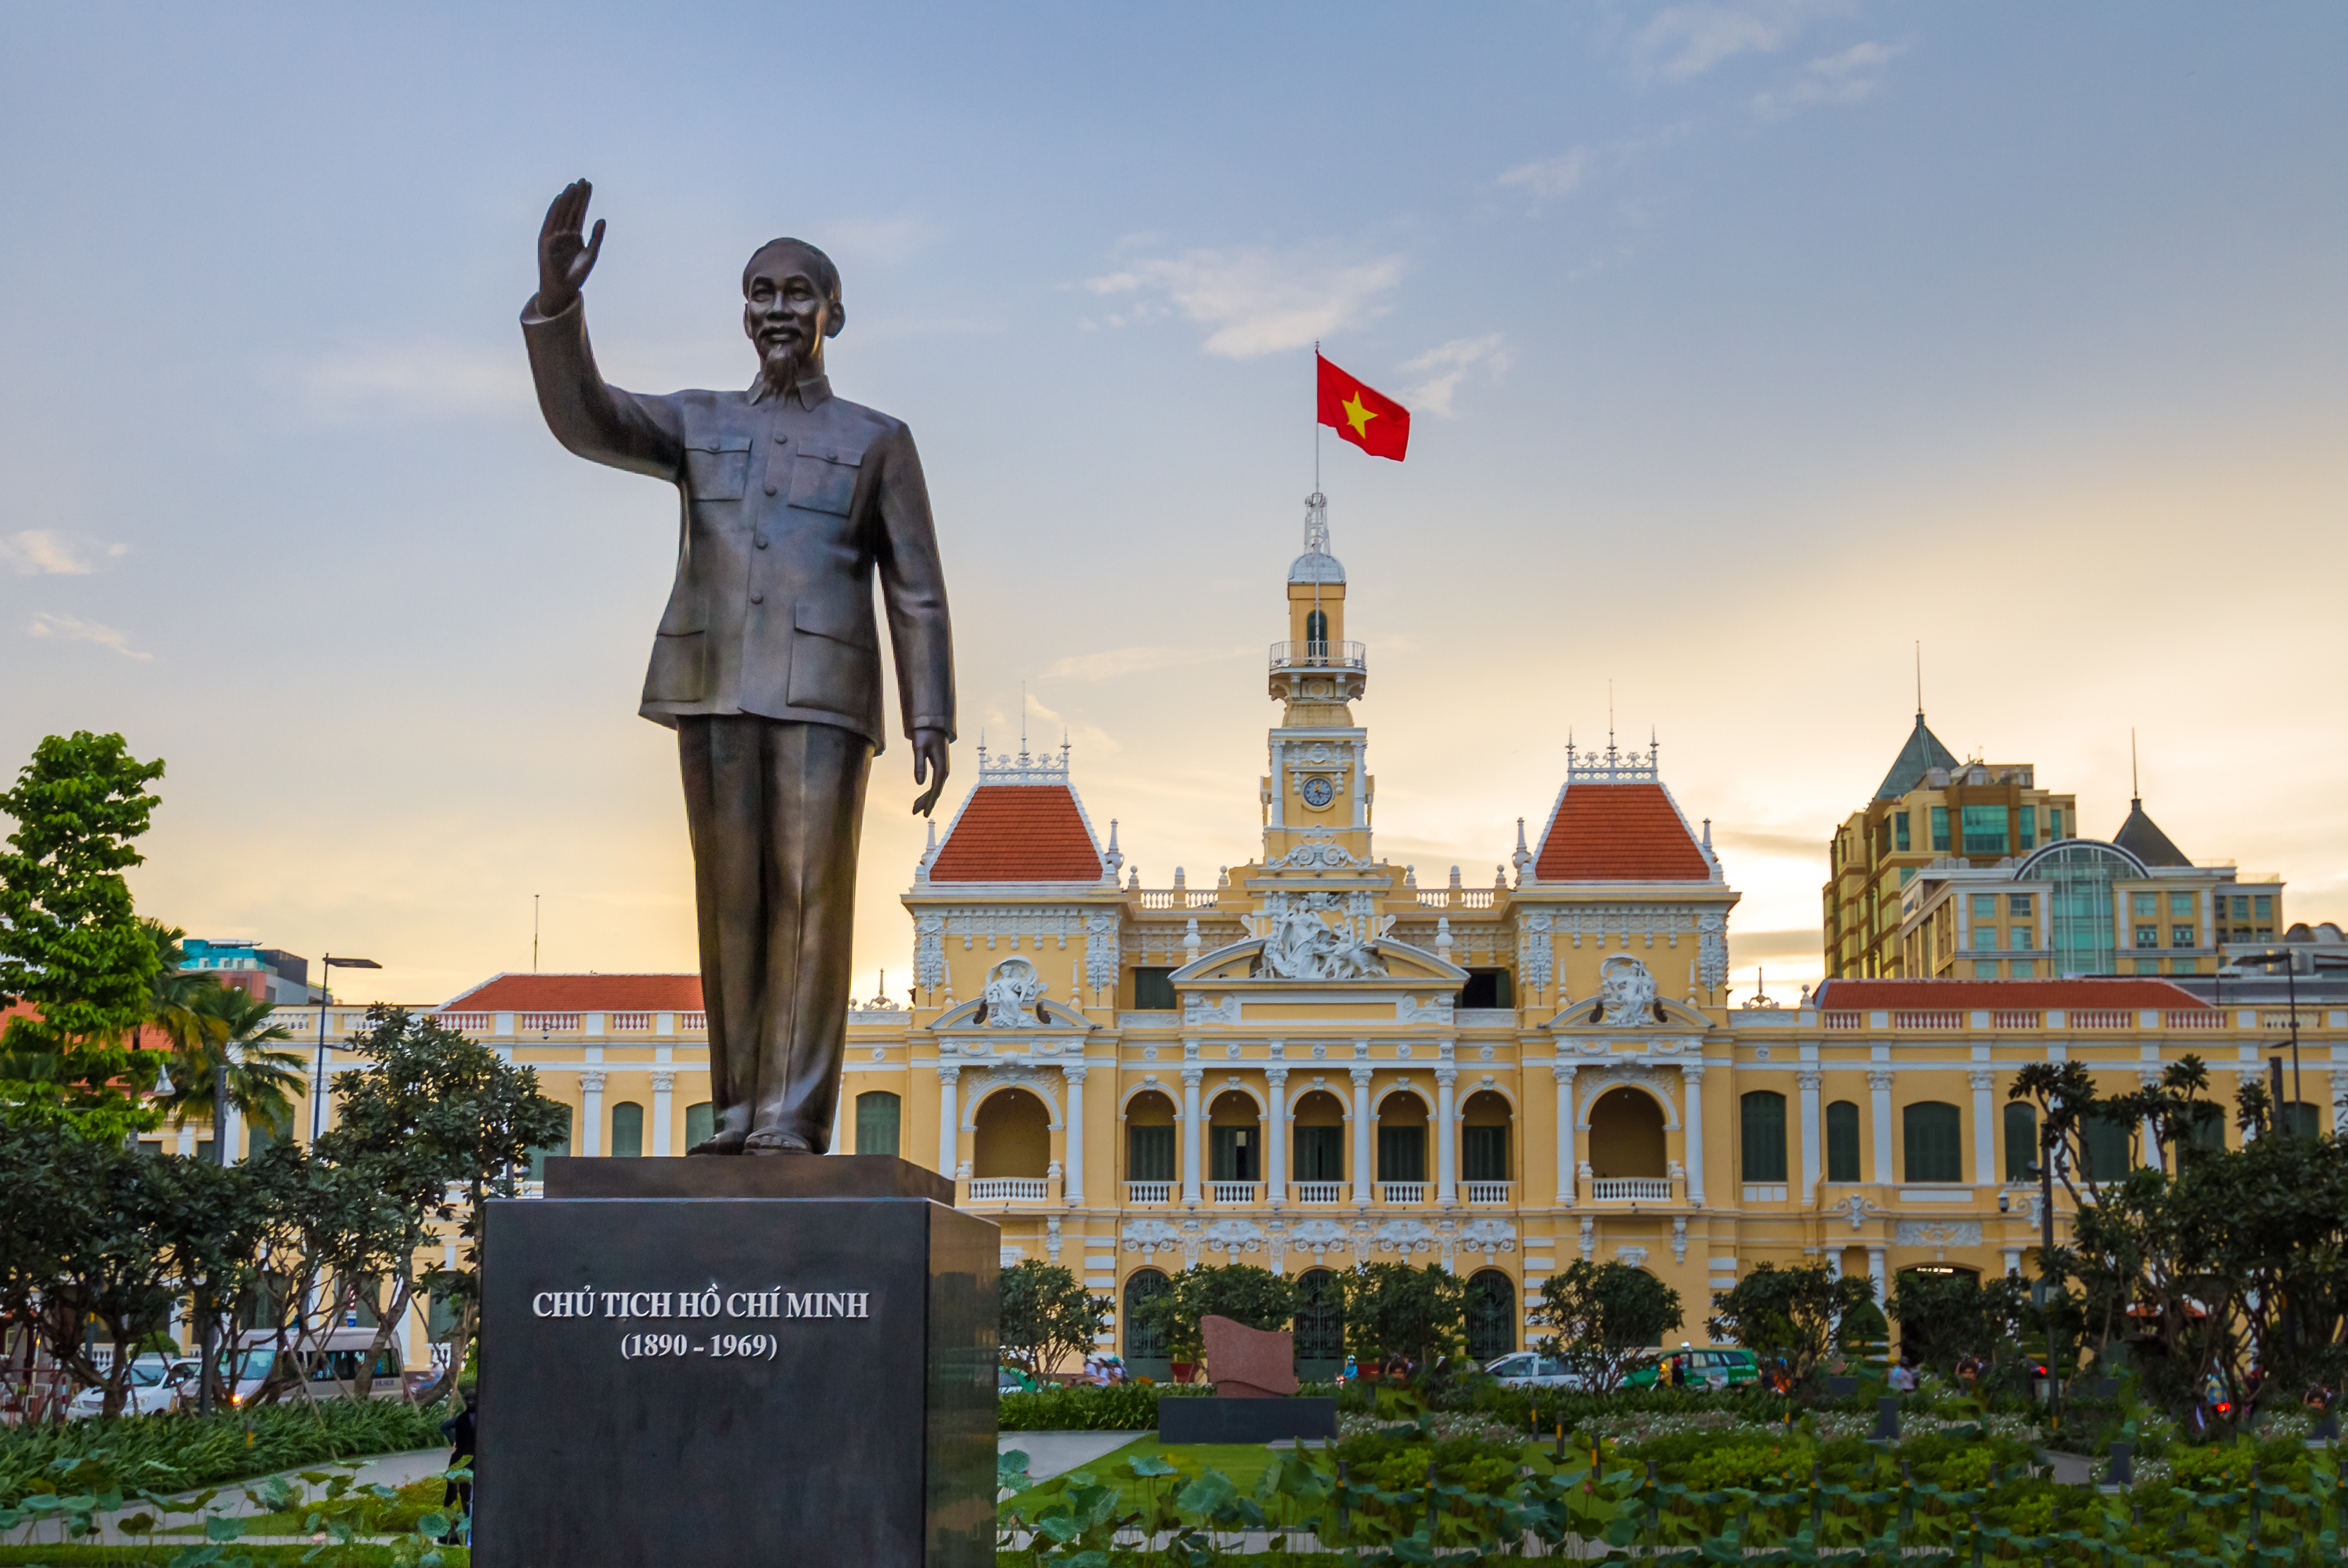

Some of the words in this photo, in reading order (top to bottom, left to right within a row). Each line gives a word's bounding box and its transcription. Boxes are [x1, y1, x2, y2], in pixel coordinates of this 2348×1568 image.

[532, 1284, 597, 1318] CHỦ
[678, 1283, 722, 1318] HỒ
[726, 1285, 781, 1318] CHÍ
[786, 1292, 870, 1318] MINH
[620, 1334, 687, 1360] (1890
[710, 1334, 778, 1361] 1969)
